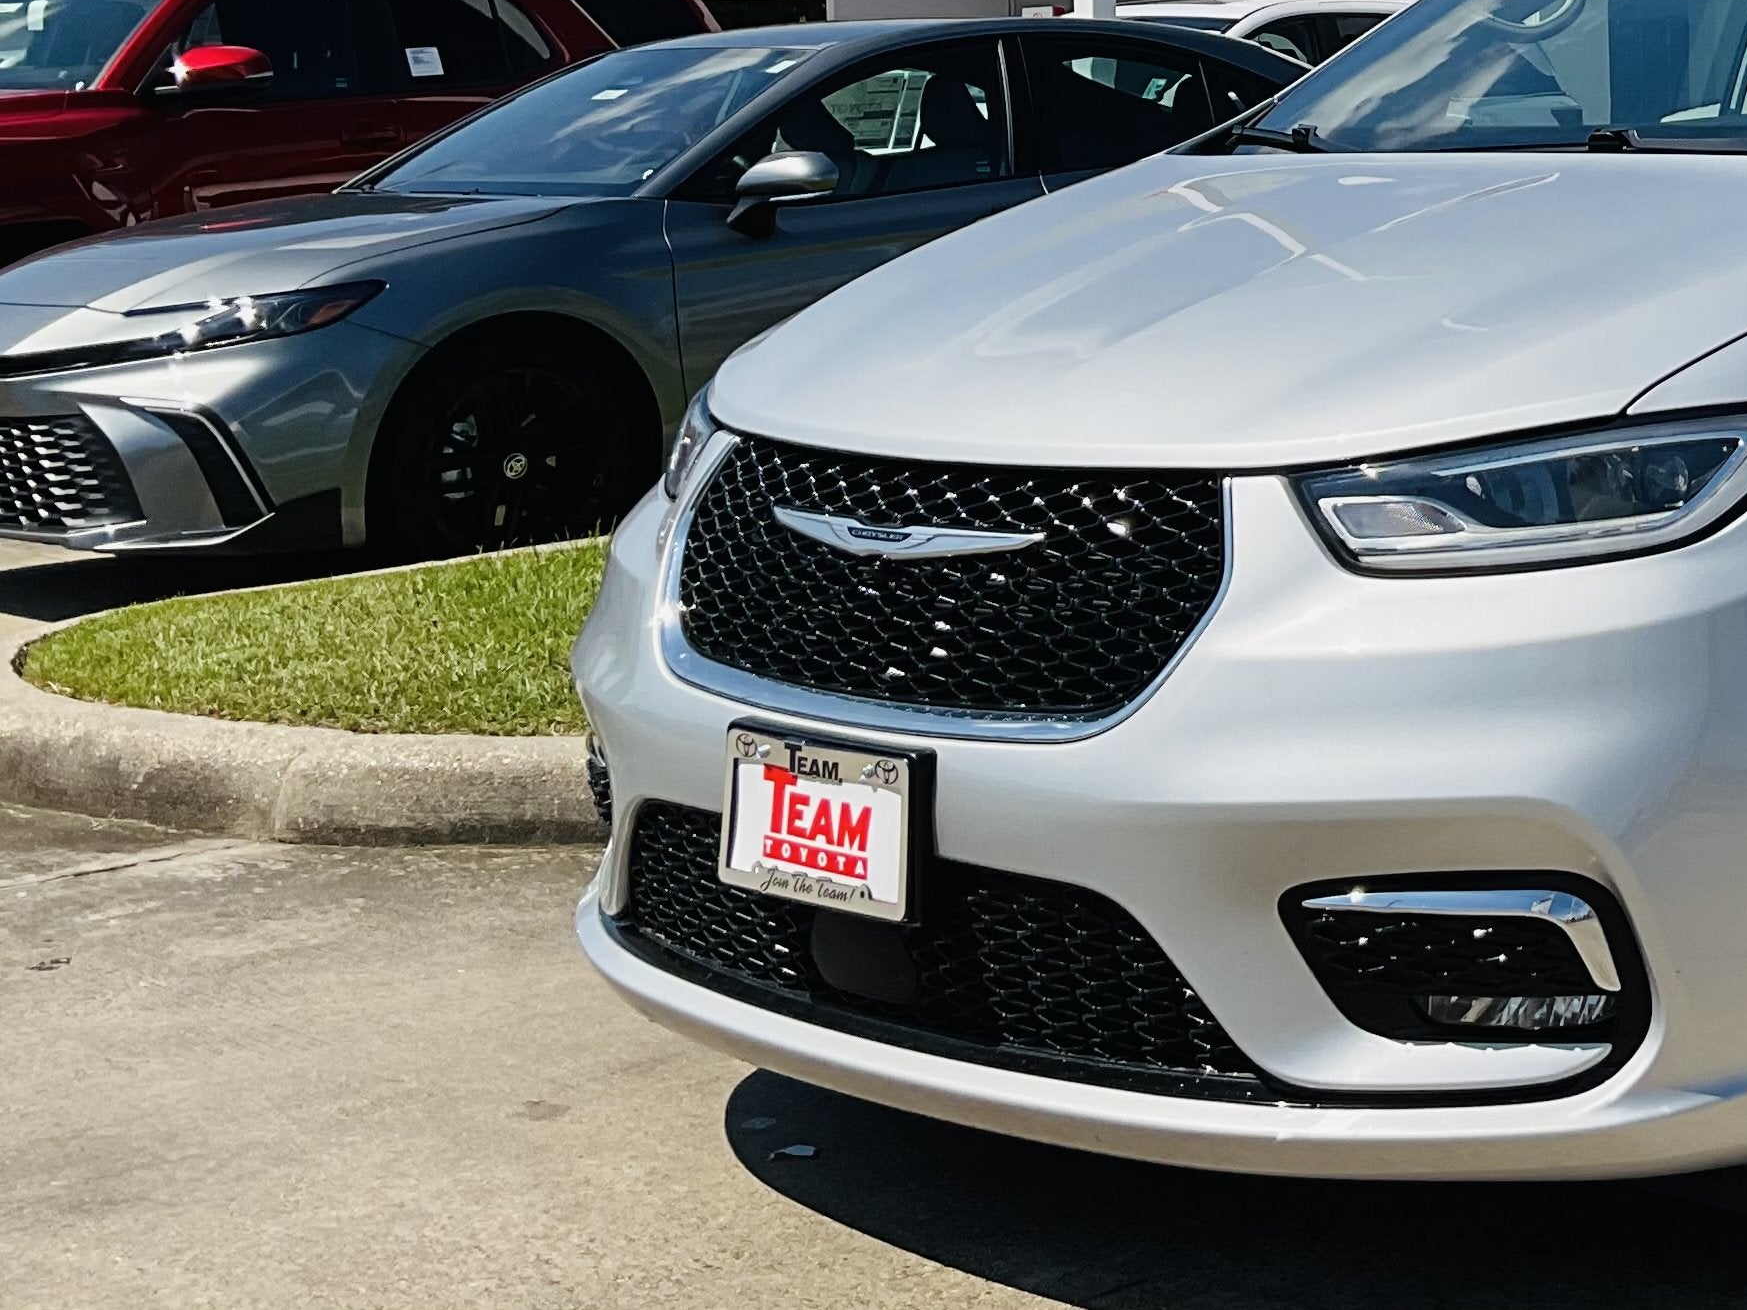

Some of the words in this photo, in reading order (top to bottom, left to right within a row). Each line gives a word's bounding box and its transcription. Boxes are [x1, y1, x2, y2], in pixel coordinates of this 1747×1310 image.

[763, 763, 872, 852] TEAM
[764, 838, 866, 876] TOYOTA
[760, 869, 789, 891] Join
[792, 874, 813, 894] The
